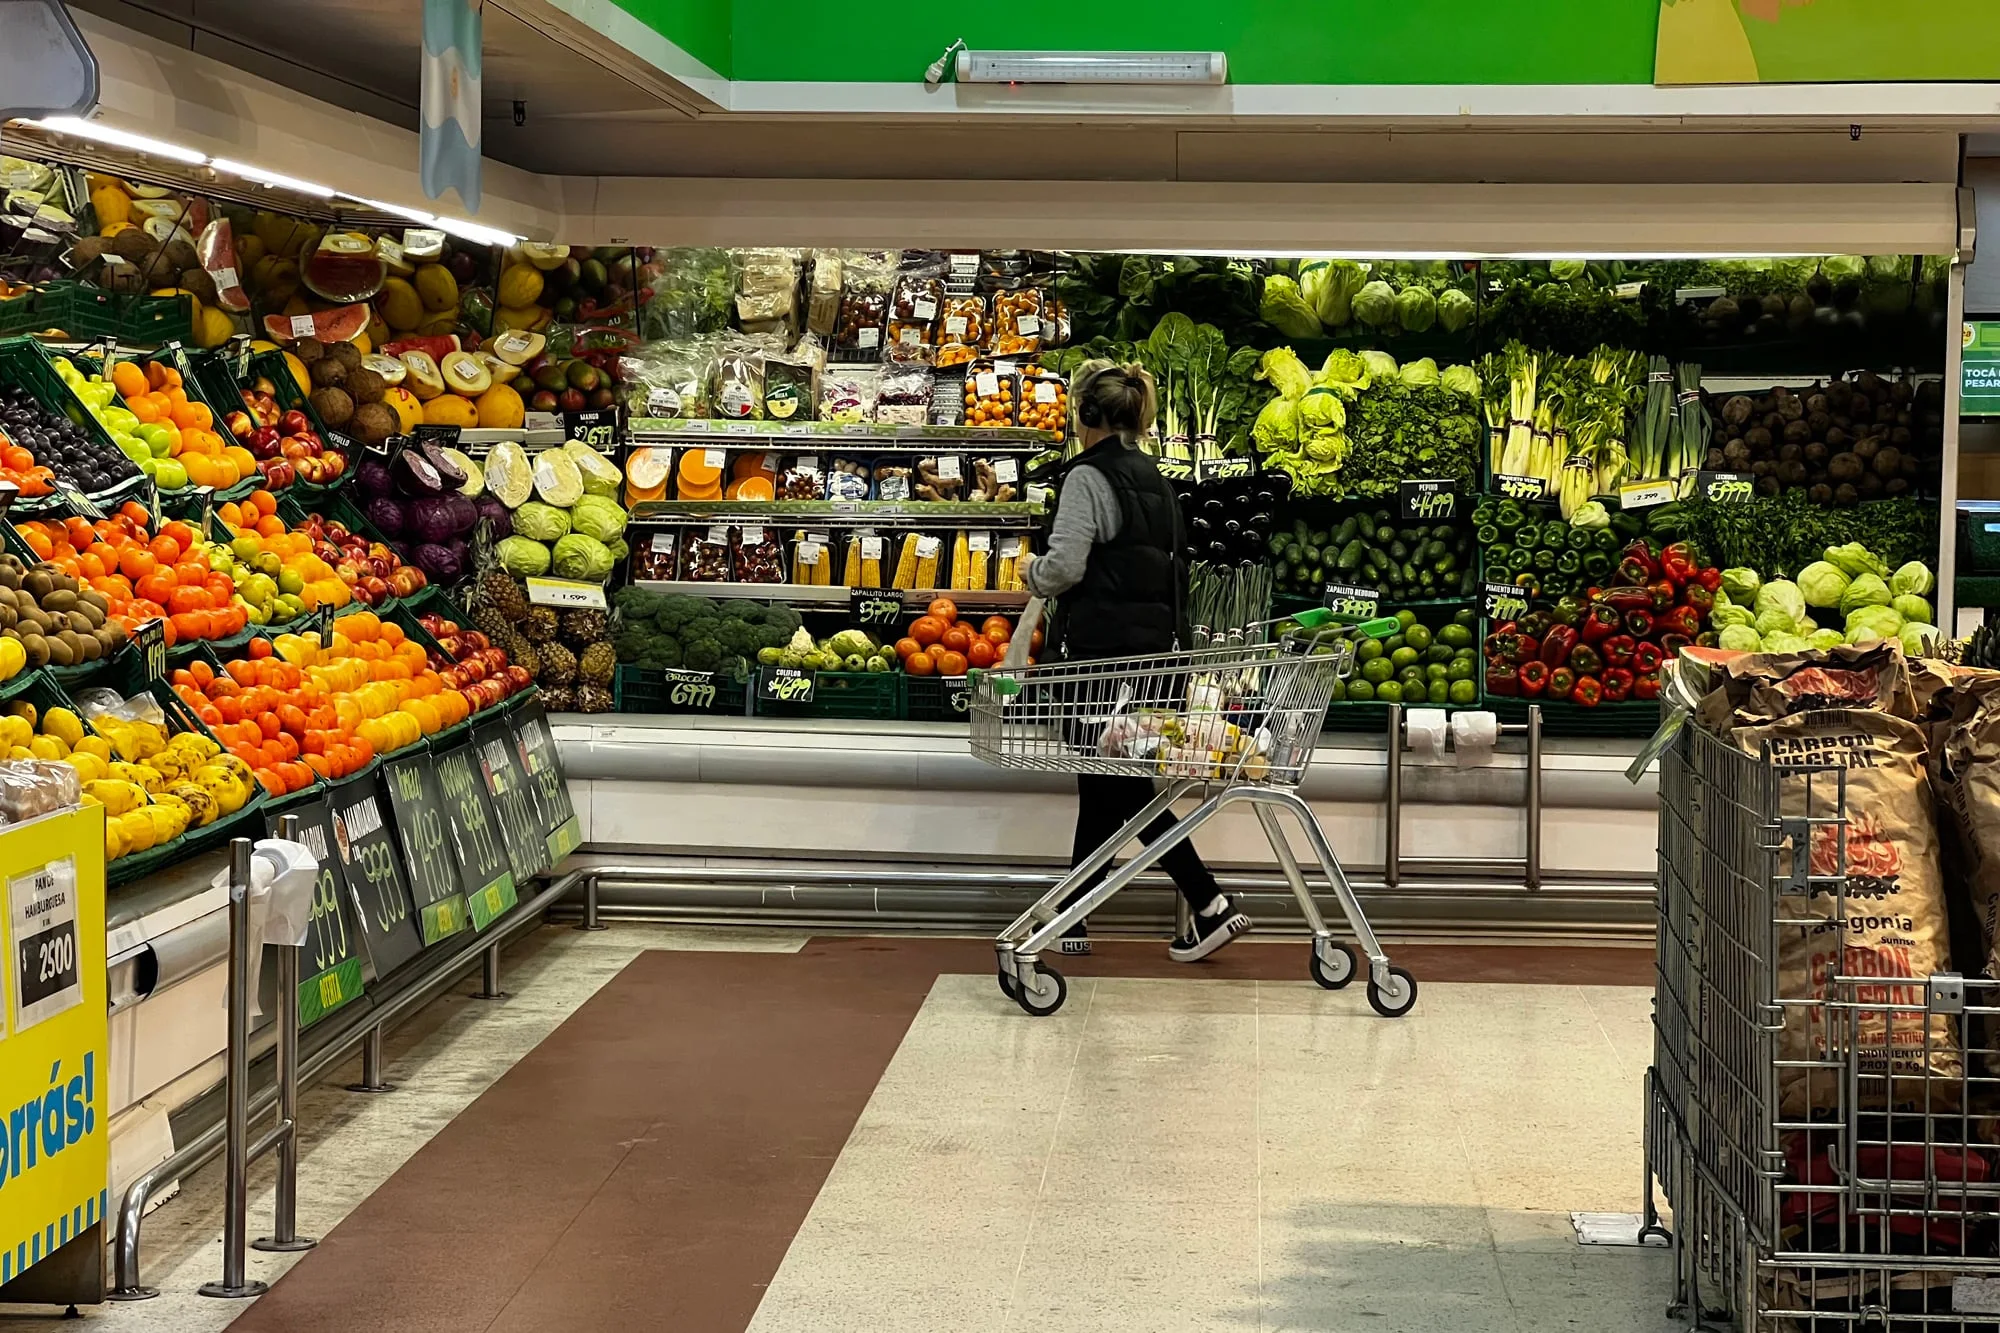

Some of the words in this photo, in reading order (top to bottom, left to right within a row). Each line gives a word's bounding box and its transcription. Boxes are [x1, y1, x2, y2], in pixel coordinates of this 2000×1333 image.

[1965, 367, 1996, 378] TOCÁ
[1418, 484, 1438, 492] PEPINO
[851, 588, 883, 597] ZAPALLITO
[883, 591, 903, 599] LARGO
[1326, 584, 1354, 596] ZAPALLITO
[1485, 584, 1510, 594] PIMIENTO
[776, 669, 801, 677] COLIFLOR
[945, 680, 967, 688] TOMATE
[1771, 734, 1875, 756] CARBON
[1775, 750, 1879, 778] VEGETAL
[34, 877, 47, 891] PAN
[24, 892, 66, 920] HAMBURGUESA
[1881, 935, 1916, 947] Sunrise
[39, 932, 74, 984] 2500
